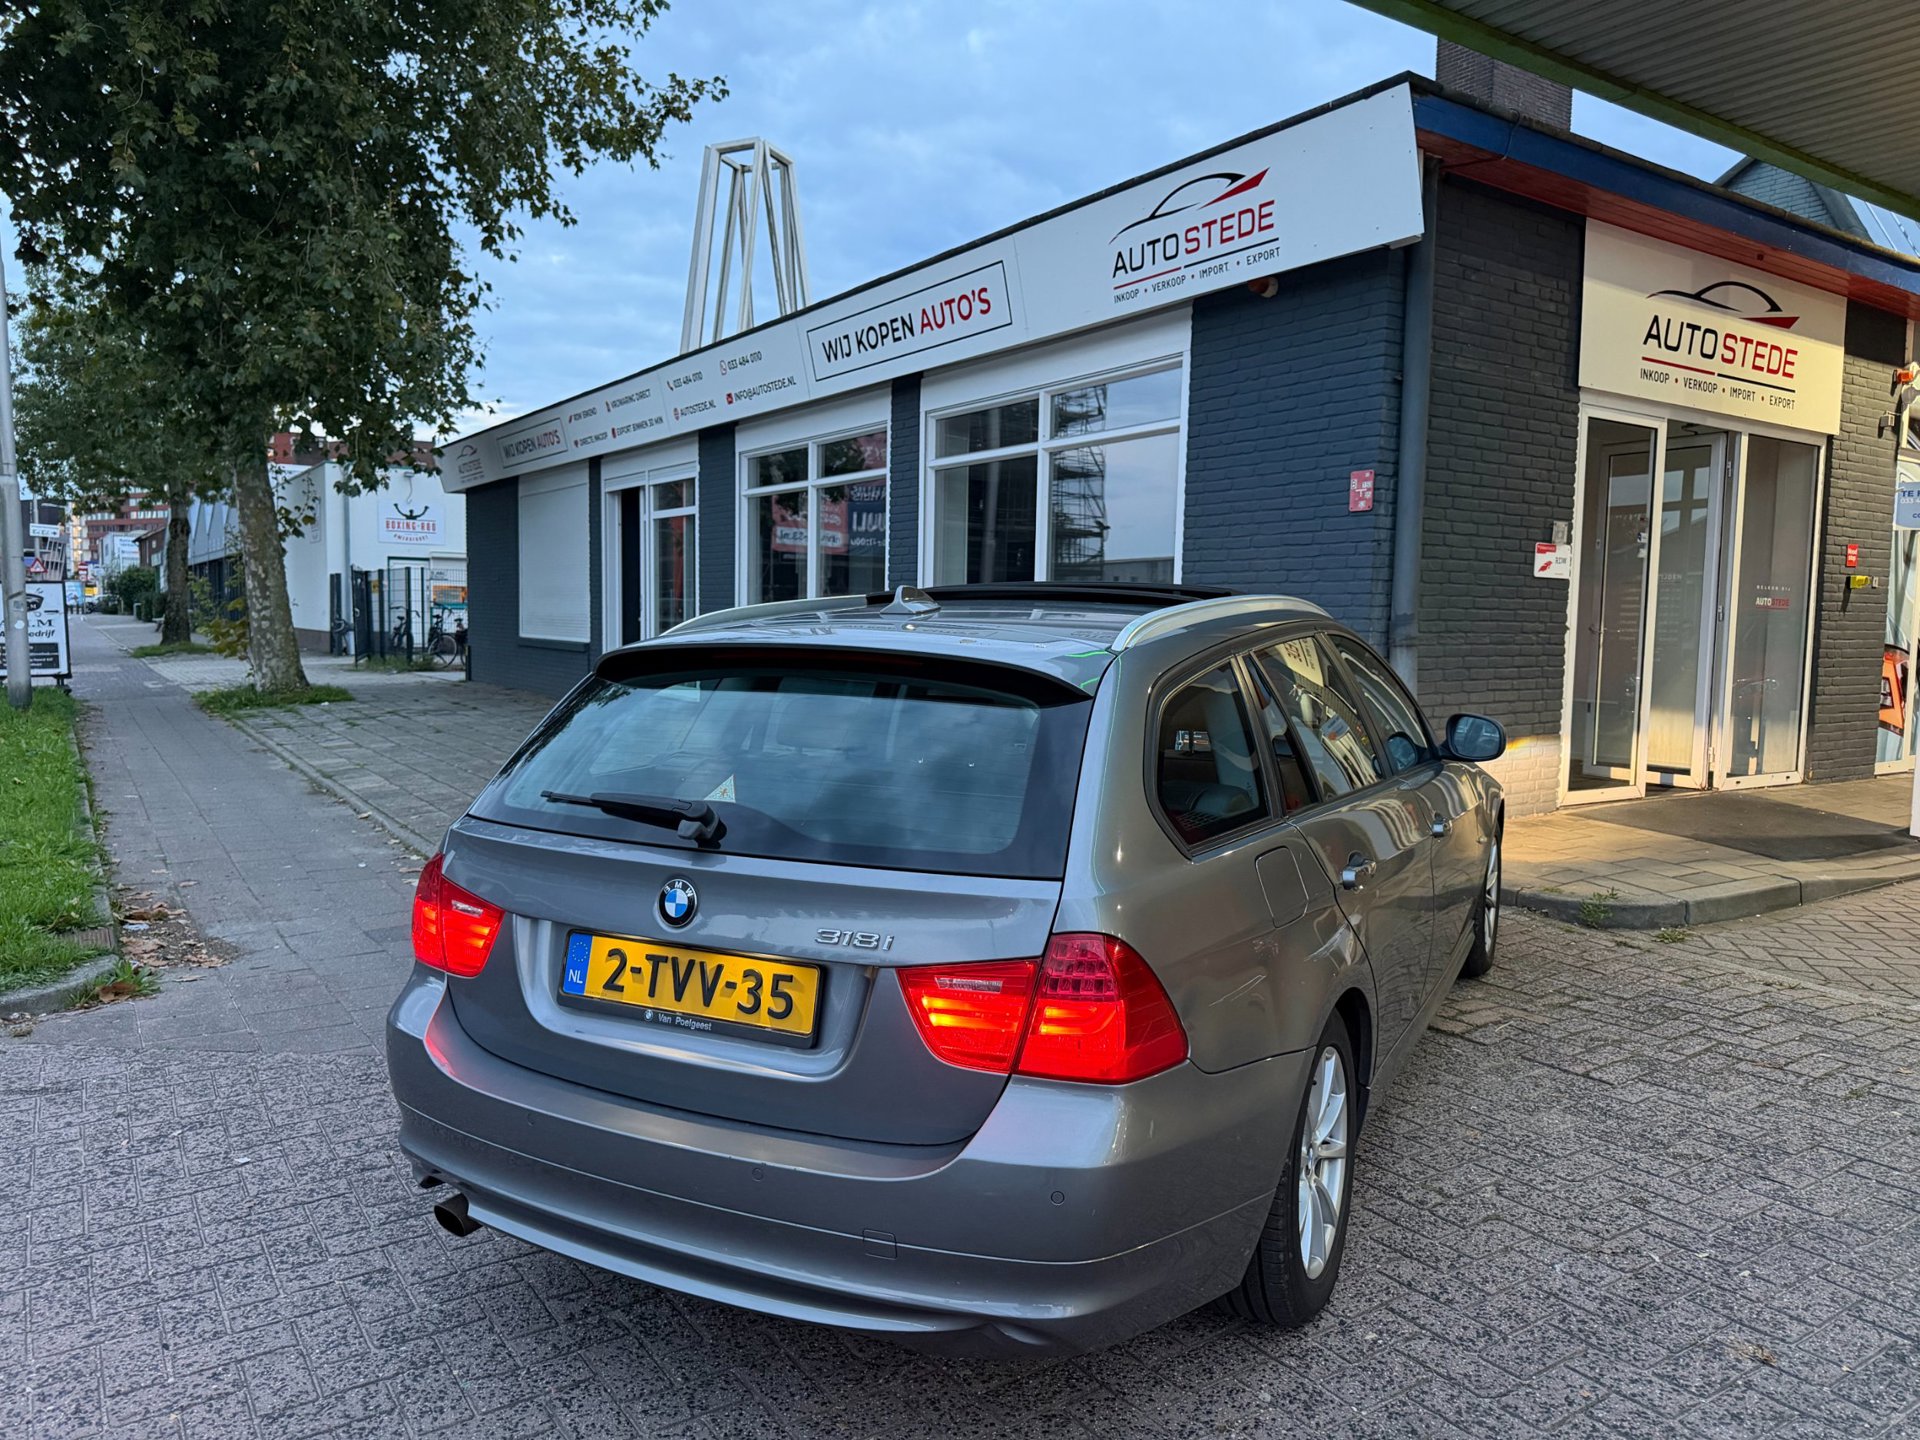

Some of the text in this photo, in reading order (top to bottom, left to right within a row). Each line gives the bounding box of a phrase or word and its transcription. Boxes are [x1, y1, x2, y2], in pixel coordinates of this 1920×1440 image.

[1112, 200, 1275, 279] AUTOSTEDE
[1113, 246, 1281, 304] INKOOP VERKOOP IMPORT EXPORT
[821, 286, 992, 364] WIJ KOPEN AUTO'S
[1643, 314, 1799, 379] AUTOSTEDE
[734, 375, 797, 402] INFO@AUTOSTEDE.NL
[1639, 367, 1796, 410] INKOOP VERKOOP IMPORT EXPORT
[680, 399, 717, 417] AUTOSTEDE.NL
[515, 437, 537, 456] KOPEN
[536, 429, 561, 449] AUTO'S
[814, 927, 895, 951] 318i
[567, 968, 584, 984] NL
[602, 947, 794, 1020] 2-TVV-35
[658, 1012, 712, 1031] Van Poelgeest
